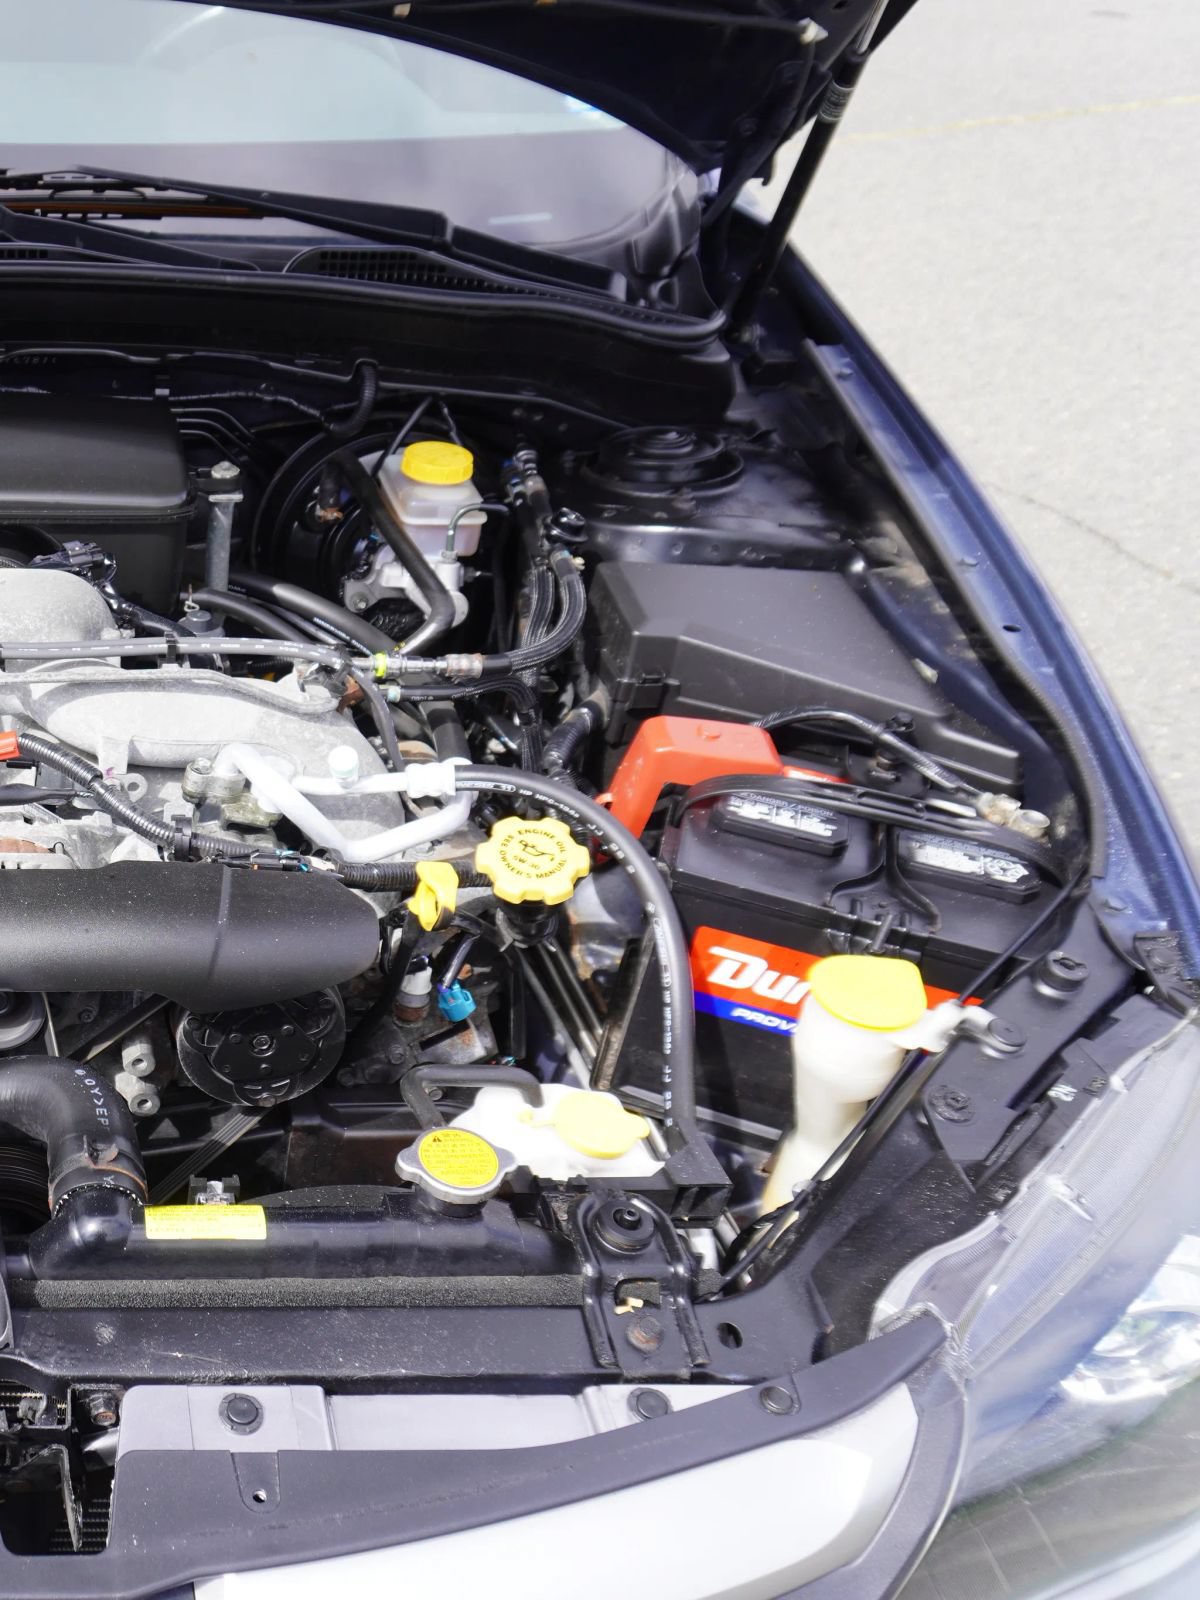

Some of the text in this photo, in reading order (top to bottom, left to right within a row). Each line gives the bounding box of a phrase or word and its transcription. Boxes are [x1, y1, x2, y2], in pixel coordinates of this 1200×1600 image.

[518, 828, 567, 854] ENGINE OIL
[501, 834, 515, 848] SEE
[535, 859, 567, 879] MANUAL
[731, 1007, 798, 1034] PROV
